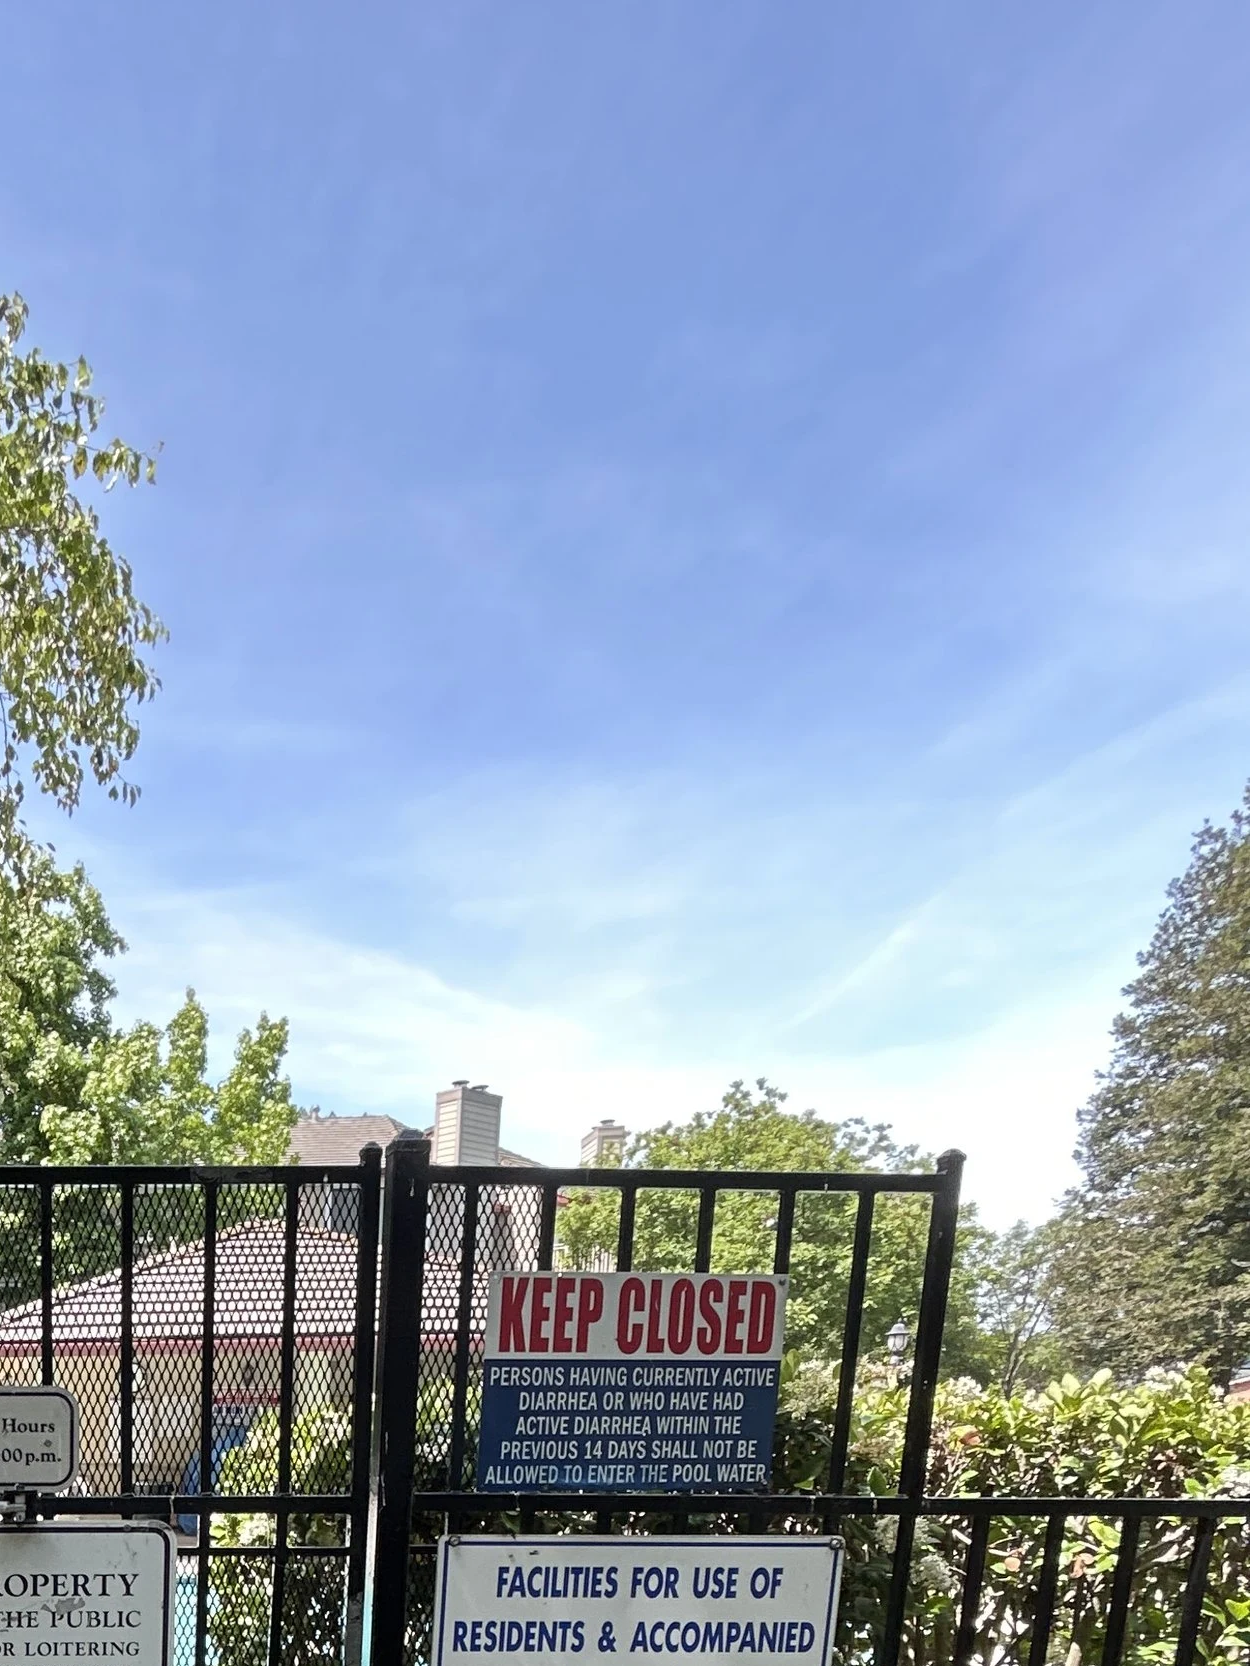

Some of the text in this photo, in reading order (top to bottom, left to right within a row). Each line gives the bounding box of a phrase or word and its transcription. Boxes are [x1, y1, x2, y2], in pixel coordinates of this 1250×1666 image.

[498, 1277, 776, 1355] KEEP CLOSED
[490, 1367, 775, 1386] PERSONS HAVING CURRENTLY ACTIVE
[519, 1392, 744, 1410] DIARRHEA OR WHO HAVE HAD
[2, 1418, 55, 1433] Hours
[516, 1416, 742, 1435] ACTIVE DIARRHEA WITHIN THE
[500, 1441, 757, 1459] PREVIOUS 14 DAYS SHALL NOT BE
[485, 1464, 766, 1484] ALLOWED TO ENTER THE POOL WATER
[496, 1566, 784, 1599] FACILITIES FOR USE OF
[51, 1610, 141, 1628] PUBLIC
[453, 1621, 815, 1653] RESIDENTS & ACCOMPANIED
[25, 1642, 139, 1657] LOITERING
